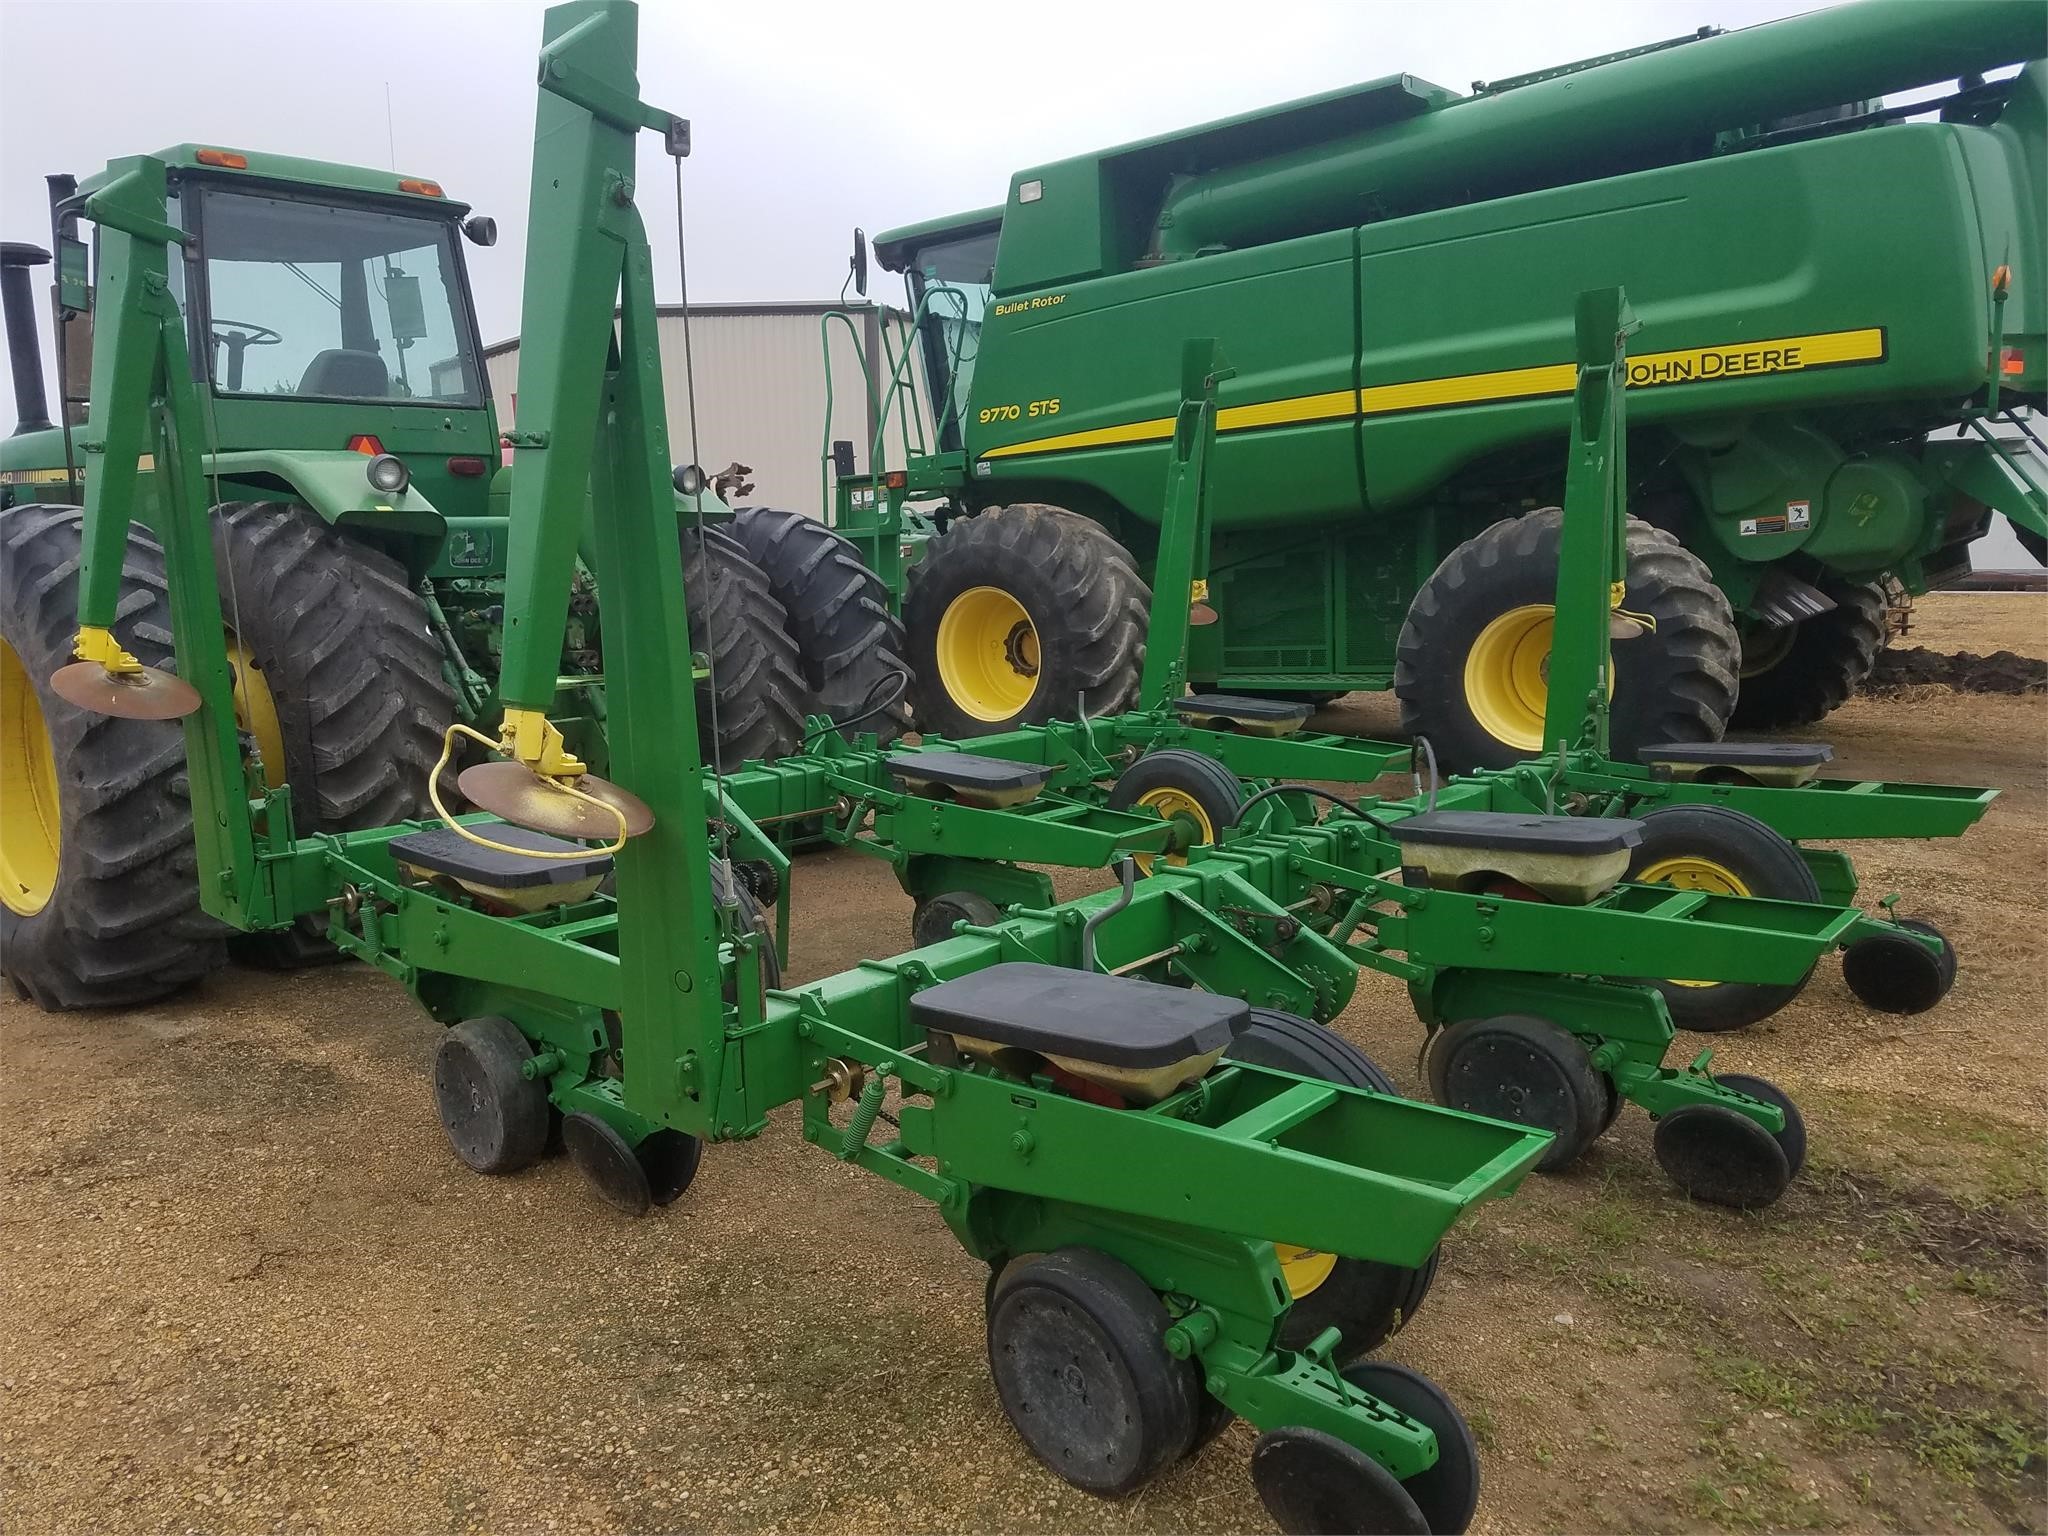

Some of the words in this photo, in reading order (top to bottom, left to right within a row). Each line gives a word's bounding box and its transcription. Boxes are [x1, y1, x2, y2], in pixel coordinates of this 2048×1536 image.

[995, 300, 1029, 316] Bullet
[1031, 294, 1066, 309] Rotor
[1701, 347, 1802, 375] DEERE
[979, 404, 1021, 424] 9770
[1028, 398, 1060, 417] STS
